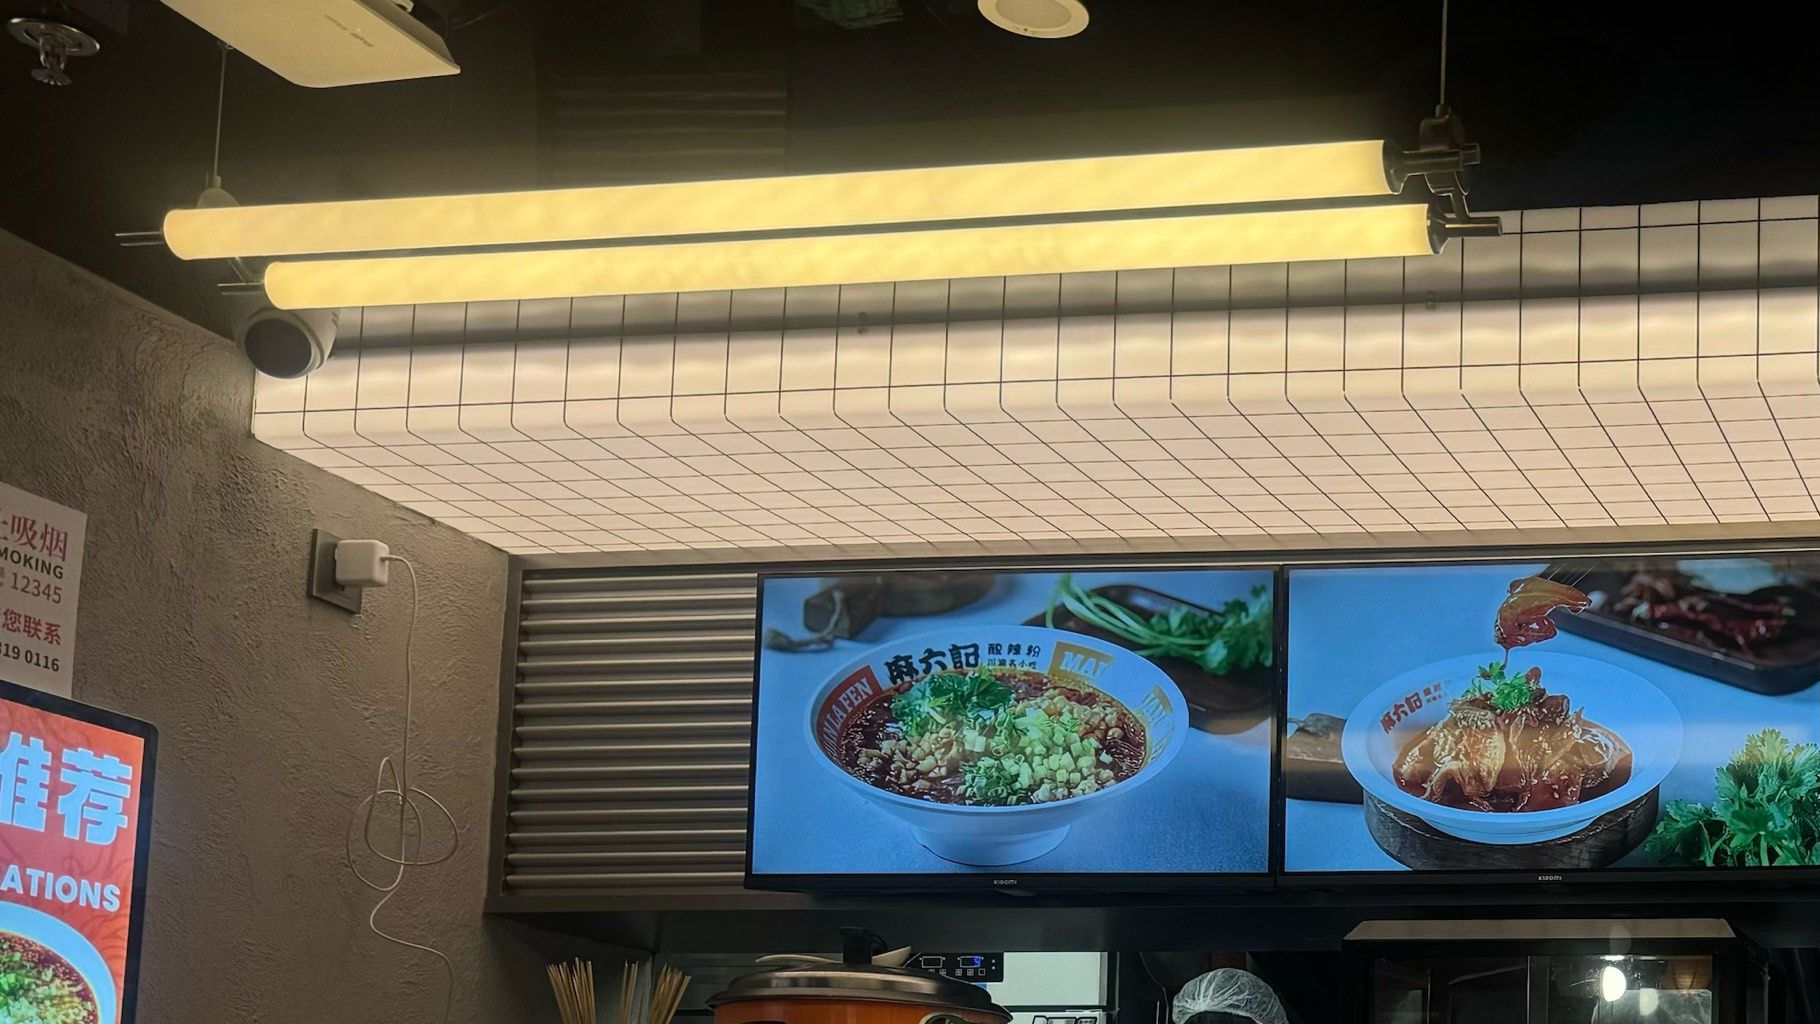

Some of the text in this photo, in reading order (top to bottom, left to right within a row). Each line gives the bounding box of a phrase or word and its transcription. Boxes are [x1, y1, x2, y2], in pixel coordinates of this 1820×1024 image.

[11, 572, 62, 605] 12345
[25, 650, 60, 672] 0116
[0, 864, 121, 912] ATIONS
